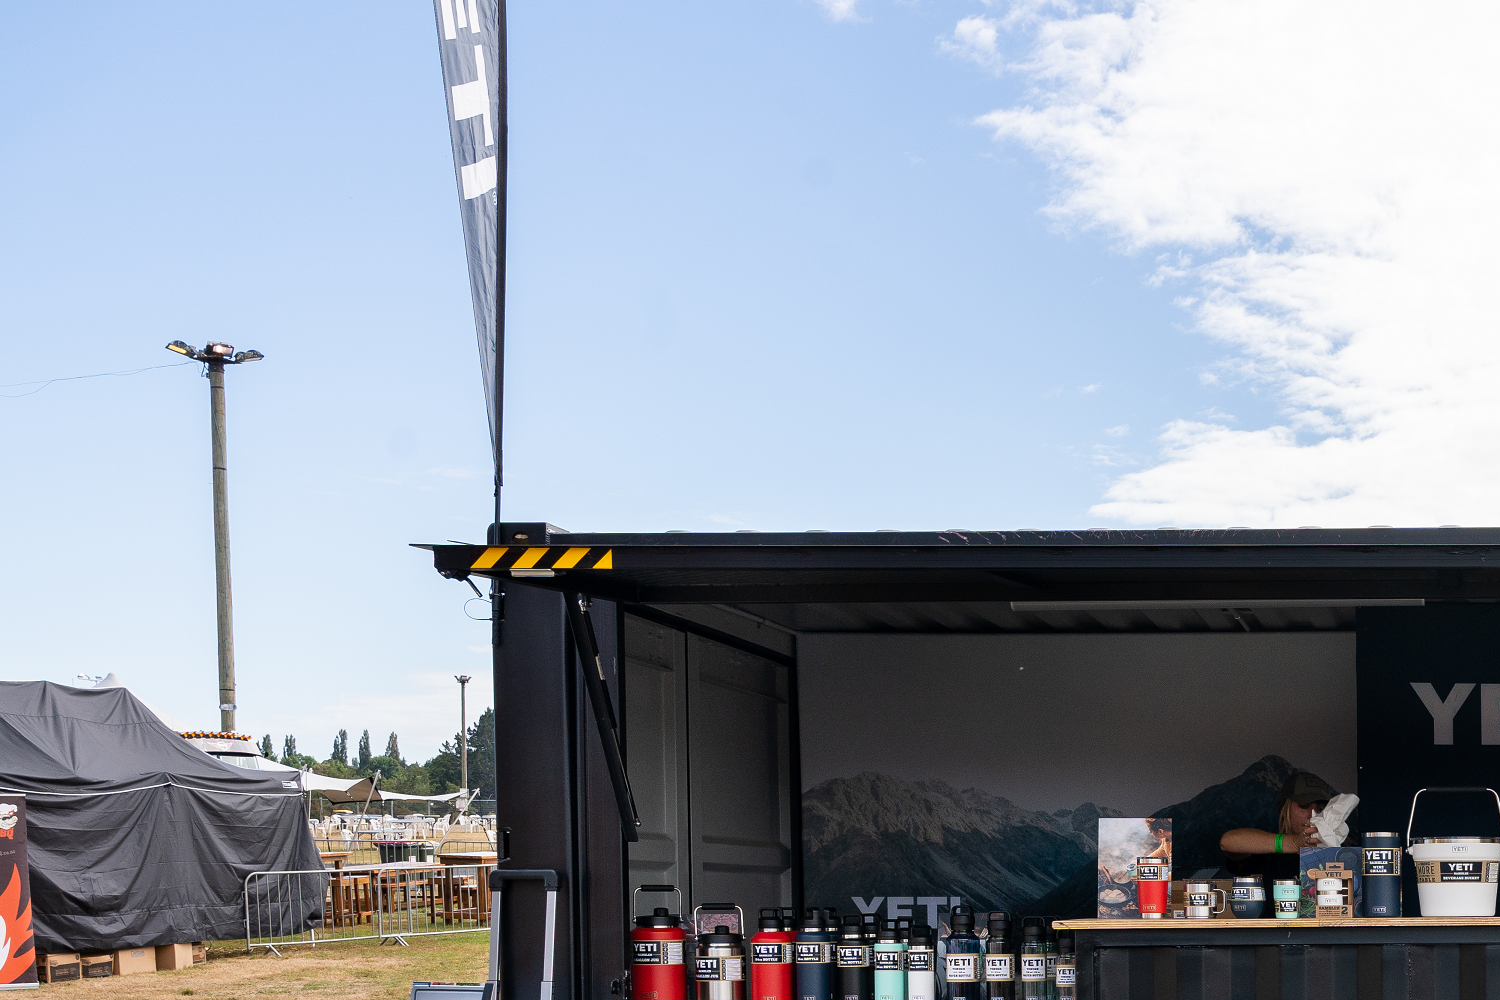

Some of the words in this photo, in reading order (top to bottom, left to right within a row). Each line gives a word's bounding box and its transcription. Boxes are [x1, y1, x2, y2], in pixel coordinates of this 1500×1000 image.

[1366, 851, 1391, 860] YETI
[1448, 863, 1473, 871] YETI
[1341, 906, 1349, 915] 2
[634, 943, 657, 952] YETI
[755, 945, 778, 954] YETI
[797, 945, 819, 953] YETI
[840, 948, 862, 957] YETI
[876, 953, 898, 961] YETI
[696, 959, 717, 969] YETI
[948, 958, 971, 967] YETI
[986, 959, 1007, 967] YETI
[1022, 959, 1043, 967] YETI
